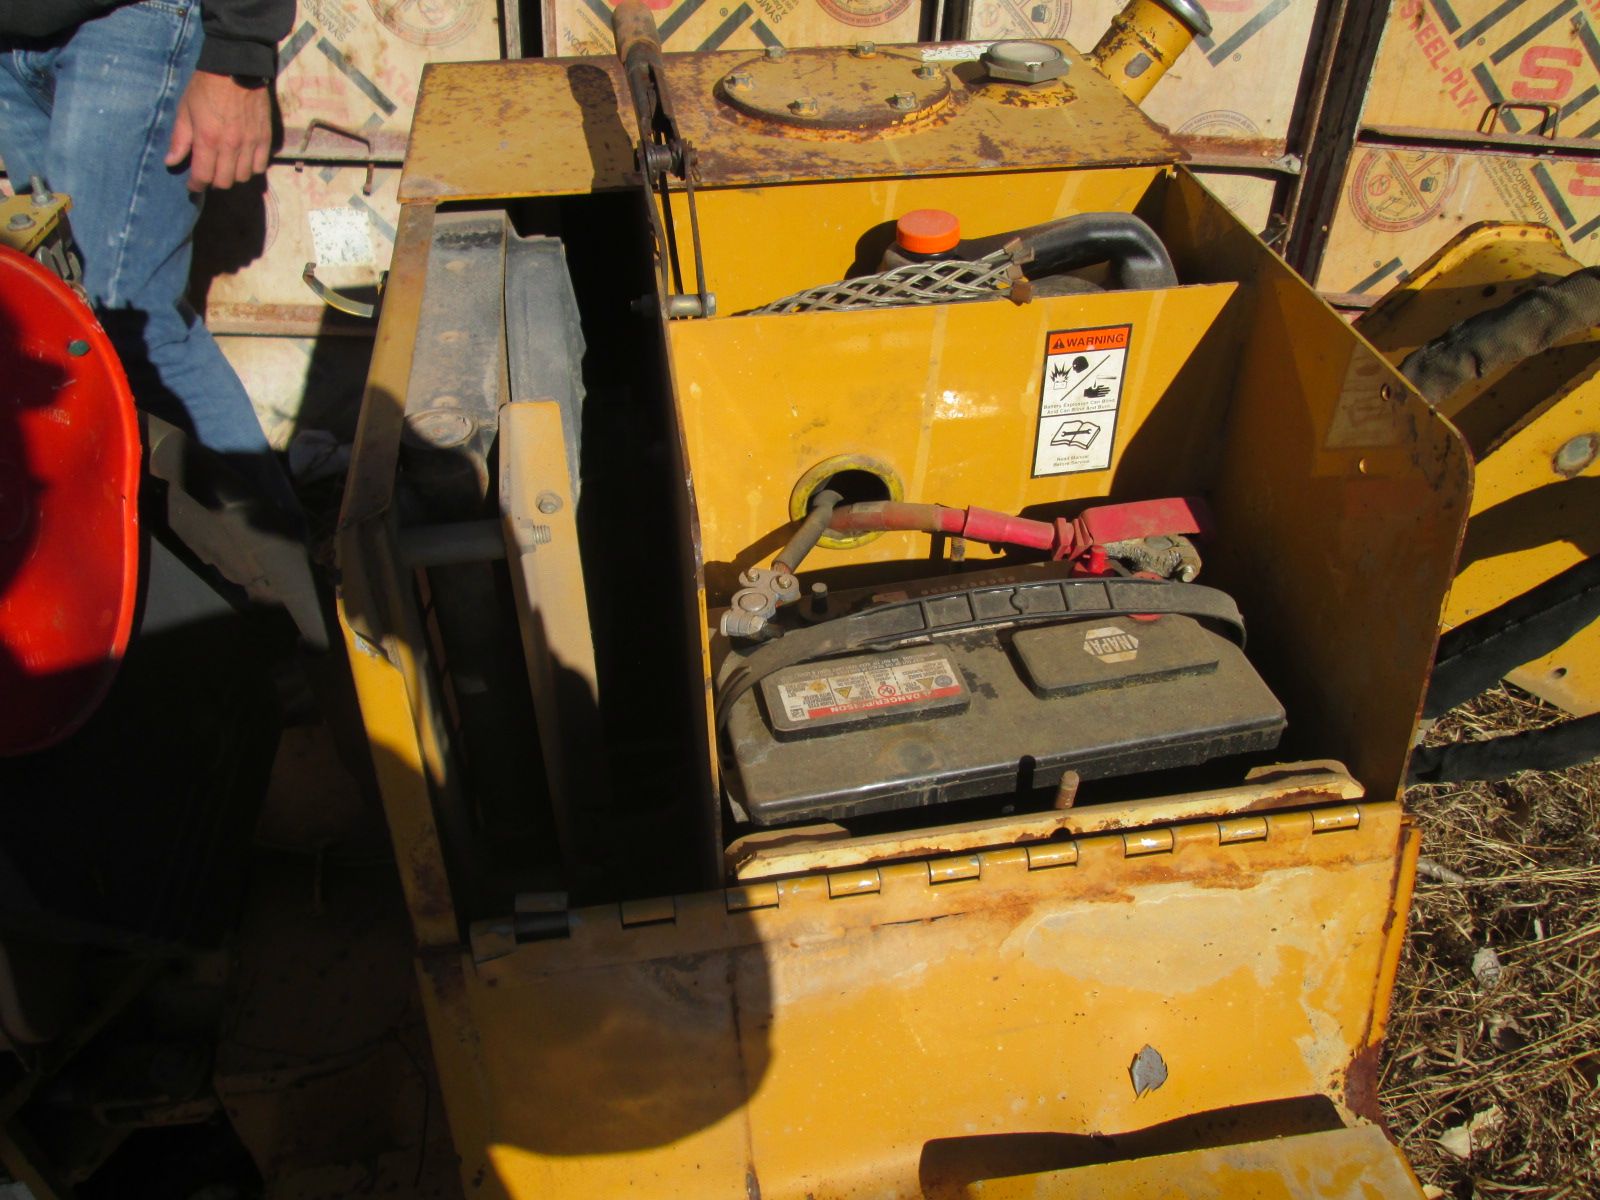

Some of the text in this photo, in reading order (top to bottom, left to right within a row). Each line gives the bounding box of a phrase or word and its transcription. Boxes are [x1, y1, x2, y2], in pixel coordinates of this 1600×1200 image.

[1511, 45, 1584, 100] S
[1511, 166, 1551, 226] CORPORATION
[1066, 333, 1124, 348] WARNING
[1091, 634, 1134, 655] NAPA
[830, 692, 919, 712] DANGER/POISON
